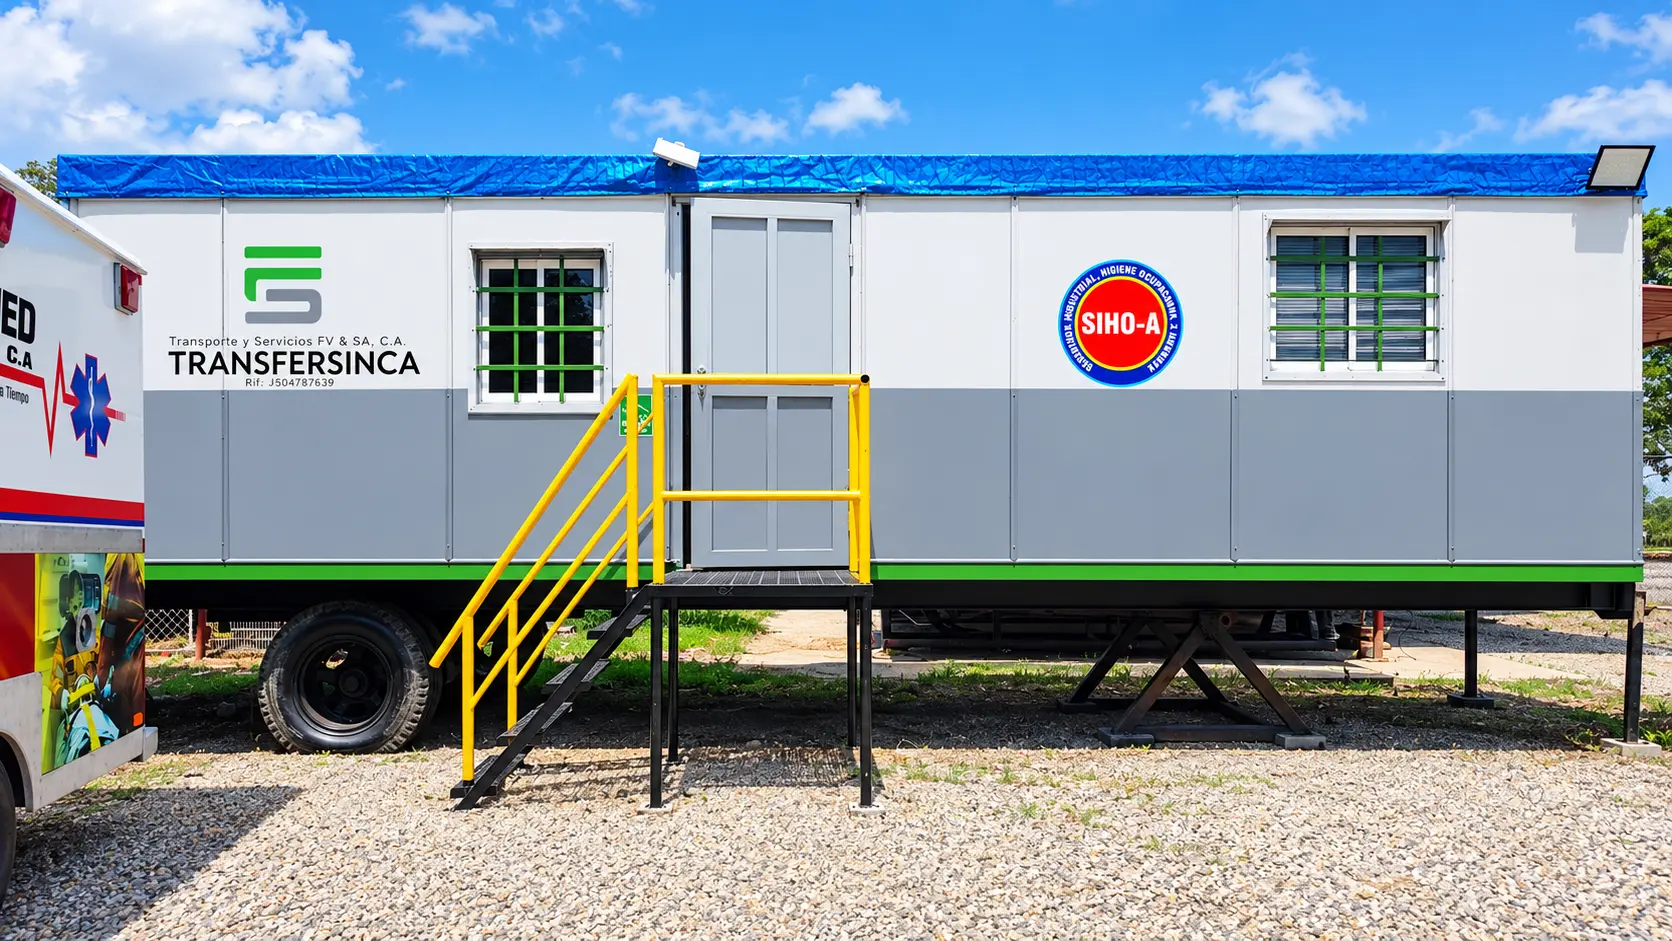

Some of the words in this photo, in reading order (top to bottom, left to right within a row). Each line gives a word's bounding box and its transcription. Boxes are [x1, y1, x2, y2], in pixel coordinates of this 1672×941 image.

[0, 287, 36, 344] ED
[1081, 311, 1162, 336] SIHO-A
[169, 336, 238, 349] Transporte
[242, 339, 250, 349] y
[254, 336, 313, 347] Servicios
[317, 336, 334, 347] FV
[339, 336, 349, 347] &
[352, 336, 375, 348] SA,
[379, 336, 407, 347] C.A.
[7, 343, 33, 371] C.A
[168, 350, 421, 375] TRANSFERSINCA
[5, 382, 30, 405] Tiempo
[245, 377, 264, 387] Rif:
[268, 377, 335, 387] J504787639
